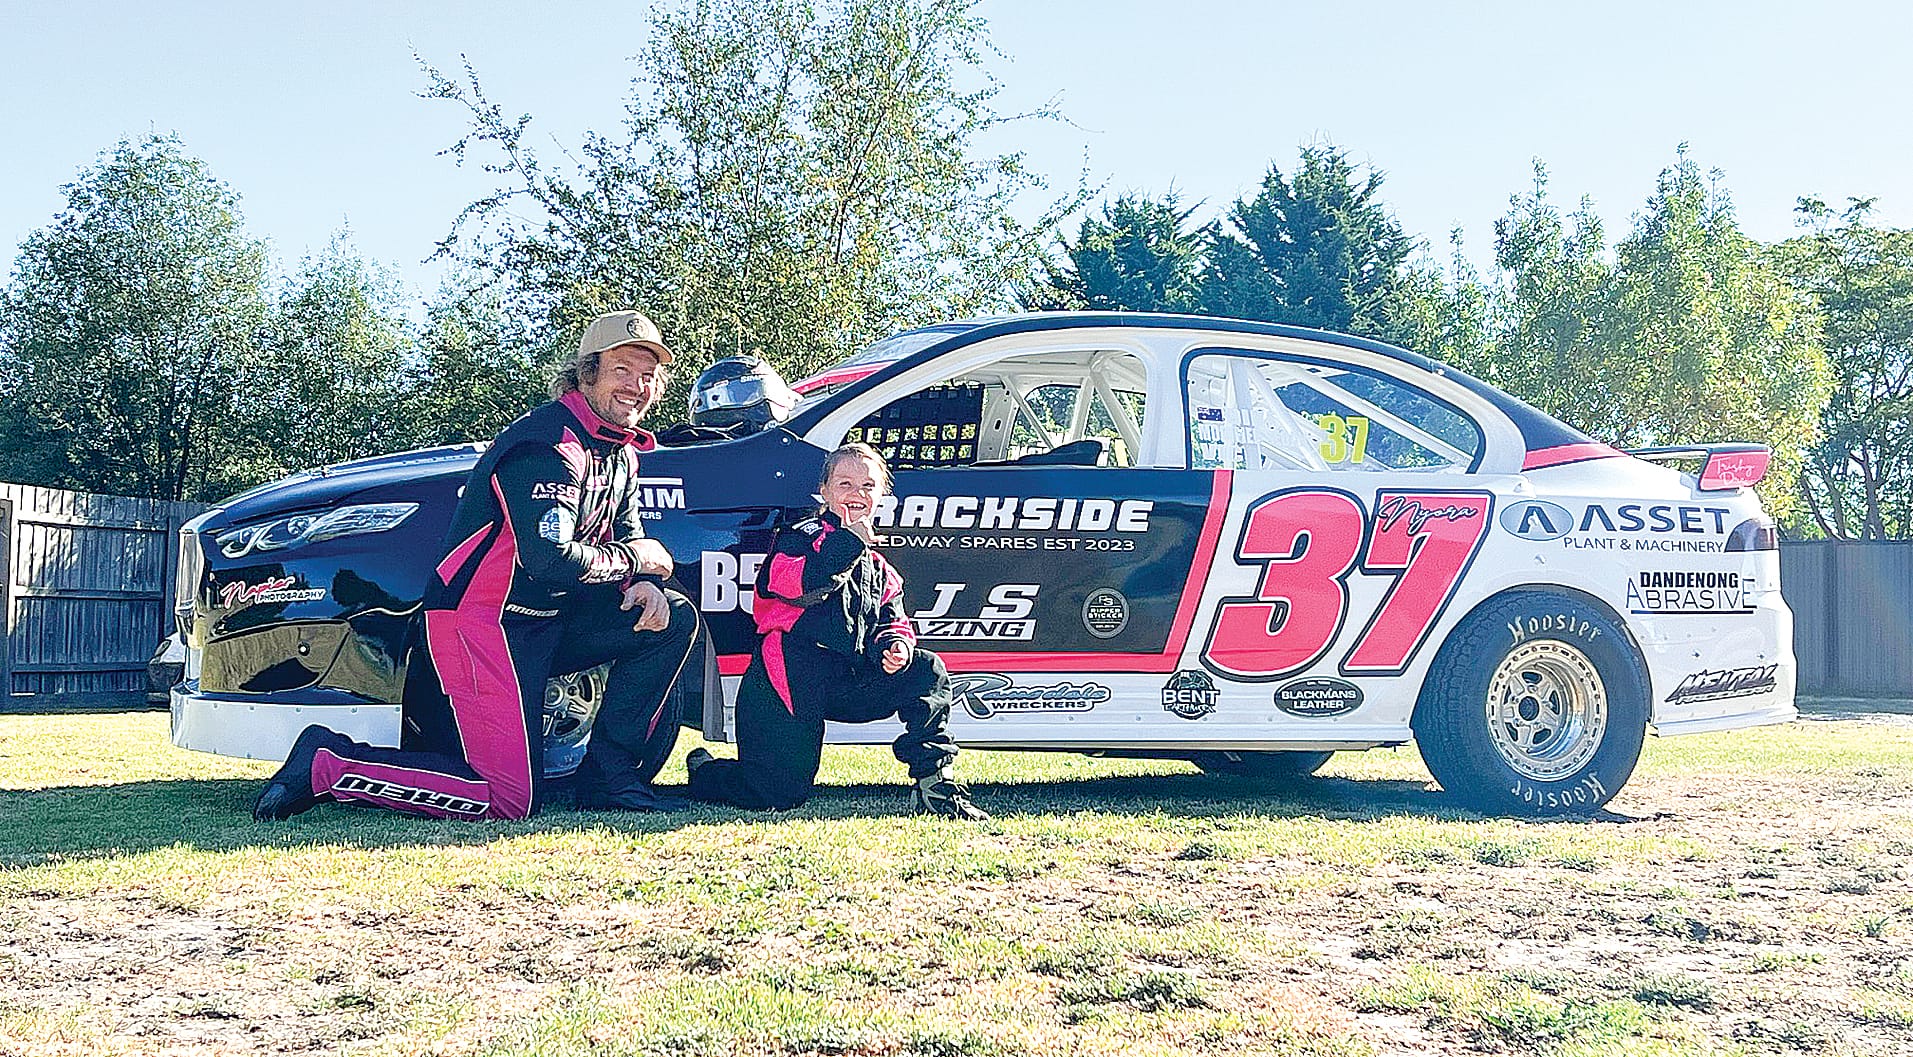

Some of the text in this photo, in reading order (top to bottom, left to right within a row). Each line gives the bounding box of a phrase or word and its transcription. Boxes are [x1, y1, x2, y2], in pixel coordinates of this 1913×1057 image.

[1320, 415, 1369, 464] 37
[533, 482, 580, 496] ASSE
[872, 495, 1154, 532] RACKSIDE
[1378, 496, 1478, 535] Nyora
[1578, 504, 1730, 534] ASSET
[960, 537, 1038, 549] SPARES
[1043, 538, 1081, 550] EST
[1085, 540, 1135, 551] 2023
[1563, 536, 1724, 553] PLANT & MACHINERY
[1199, 486, 1496, 682] 37
[1640, 571, 1739, 588] DANDENONG
[258, 589, 326, 603] PHOTOGRAPHY
[913, 583, 1041, 619] J S
[1625, 577, 1758, 610] ABRASIVE
[910, 620, 1027, 637] AZING
[1506, 610, 1603, 648] Hoosier
[1162, 689, 1219, 705] BENT
[1281, 690, 1357, 700] BLACKMANS
[991, 701, 1088, 709] WRECKERS
[1293, 700, 1345, 709] LEATHER
[1511, 770, 1607, 812] Hoosier
